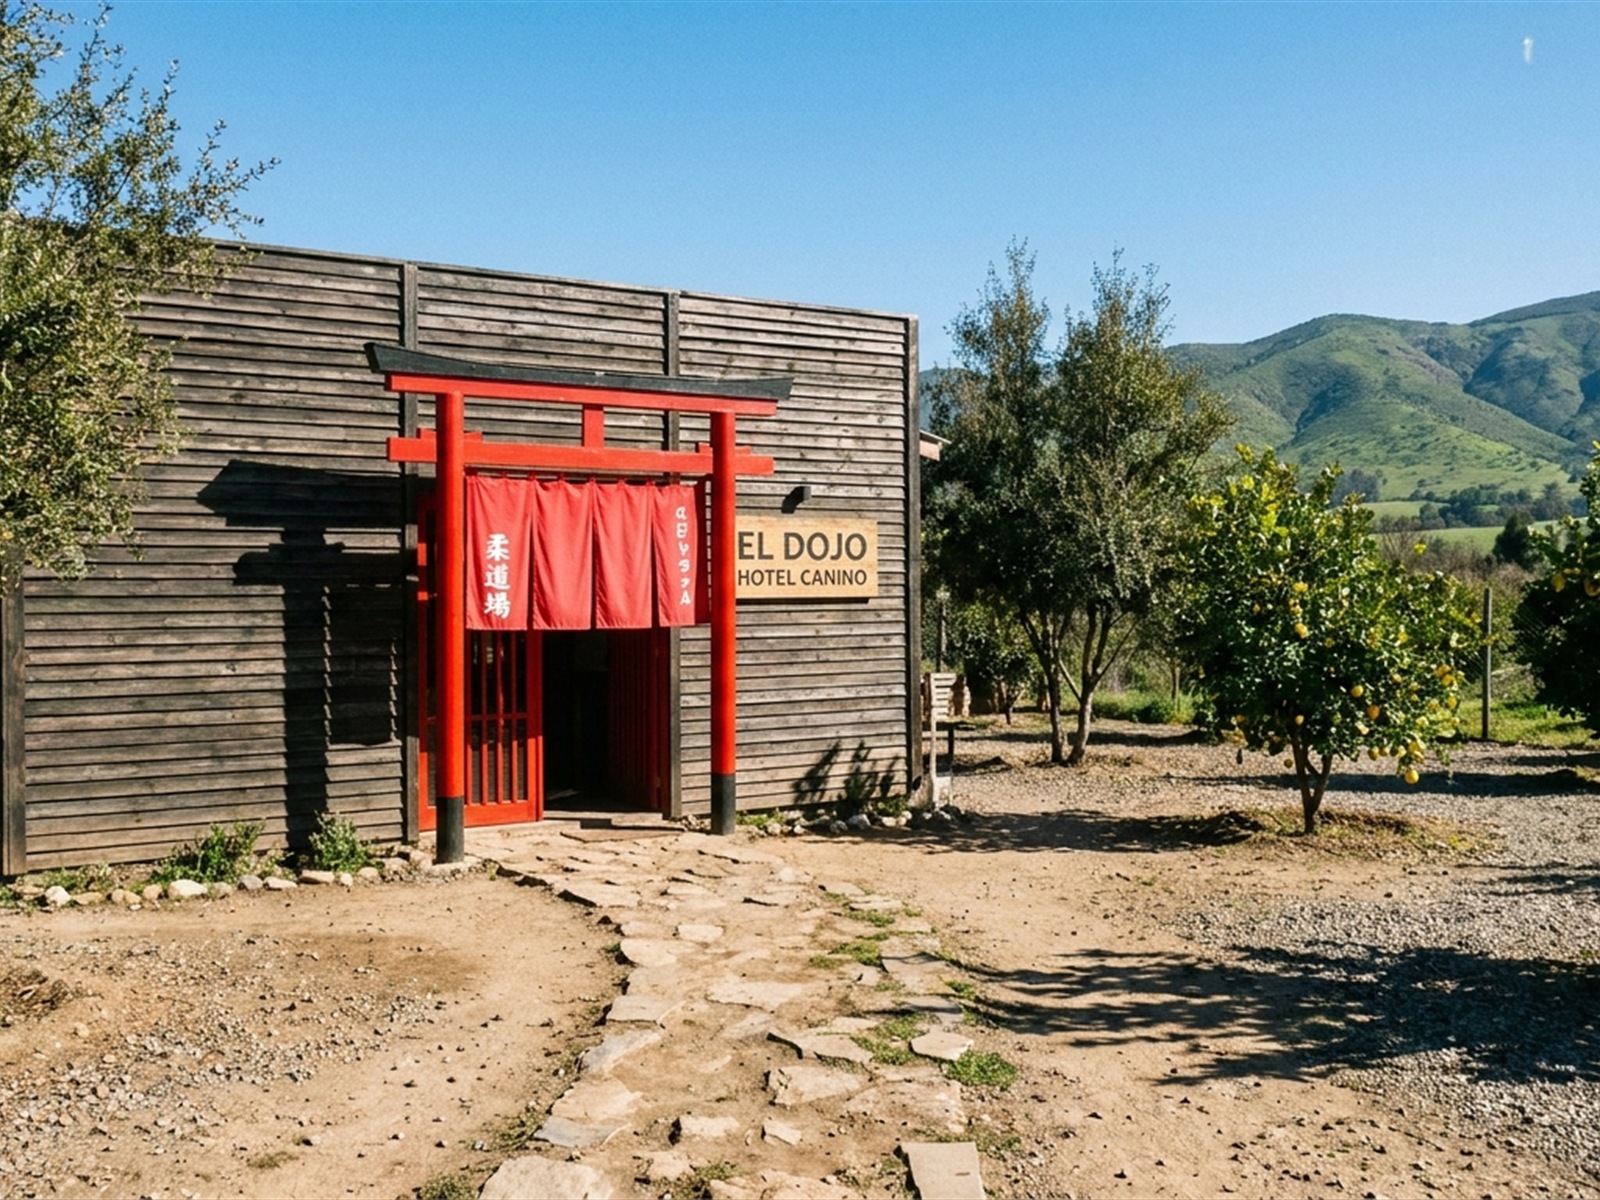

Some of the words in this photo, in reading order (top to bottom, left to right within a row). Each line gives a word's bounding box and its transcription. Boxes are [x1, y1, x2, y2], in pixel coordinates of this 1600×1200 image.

[738, 531, 774, 560] EL
[784, 532, 867, 561] DOJO
[484, 533, 511, 619] 柔道場
[738, 569, 796, 586] HOTEL
[800, 569, 867, 586] CANINO
